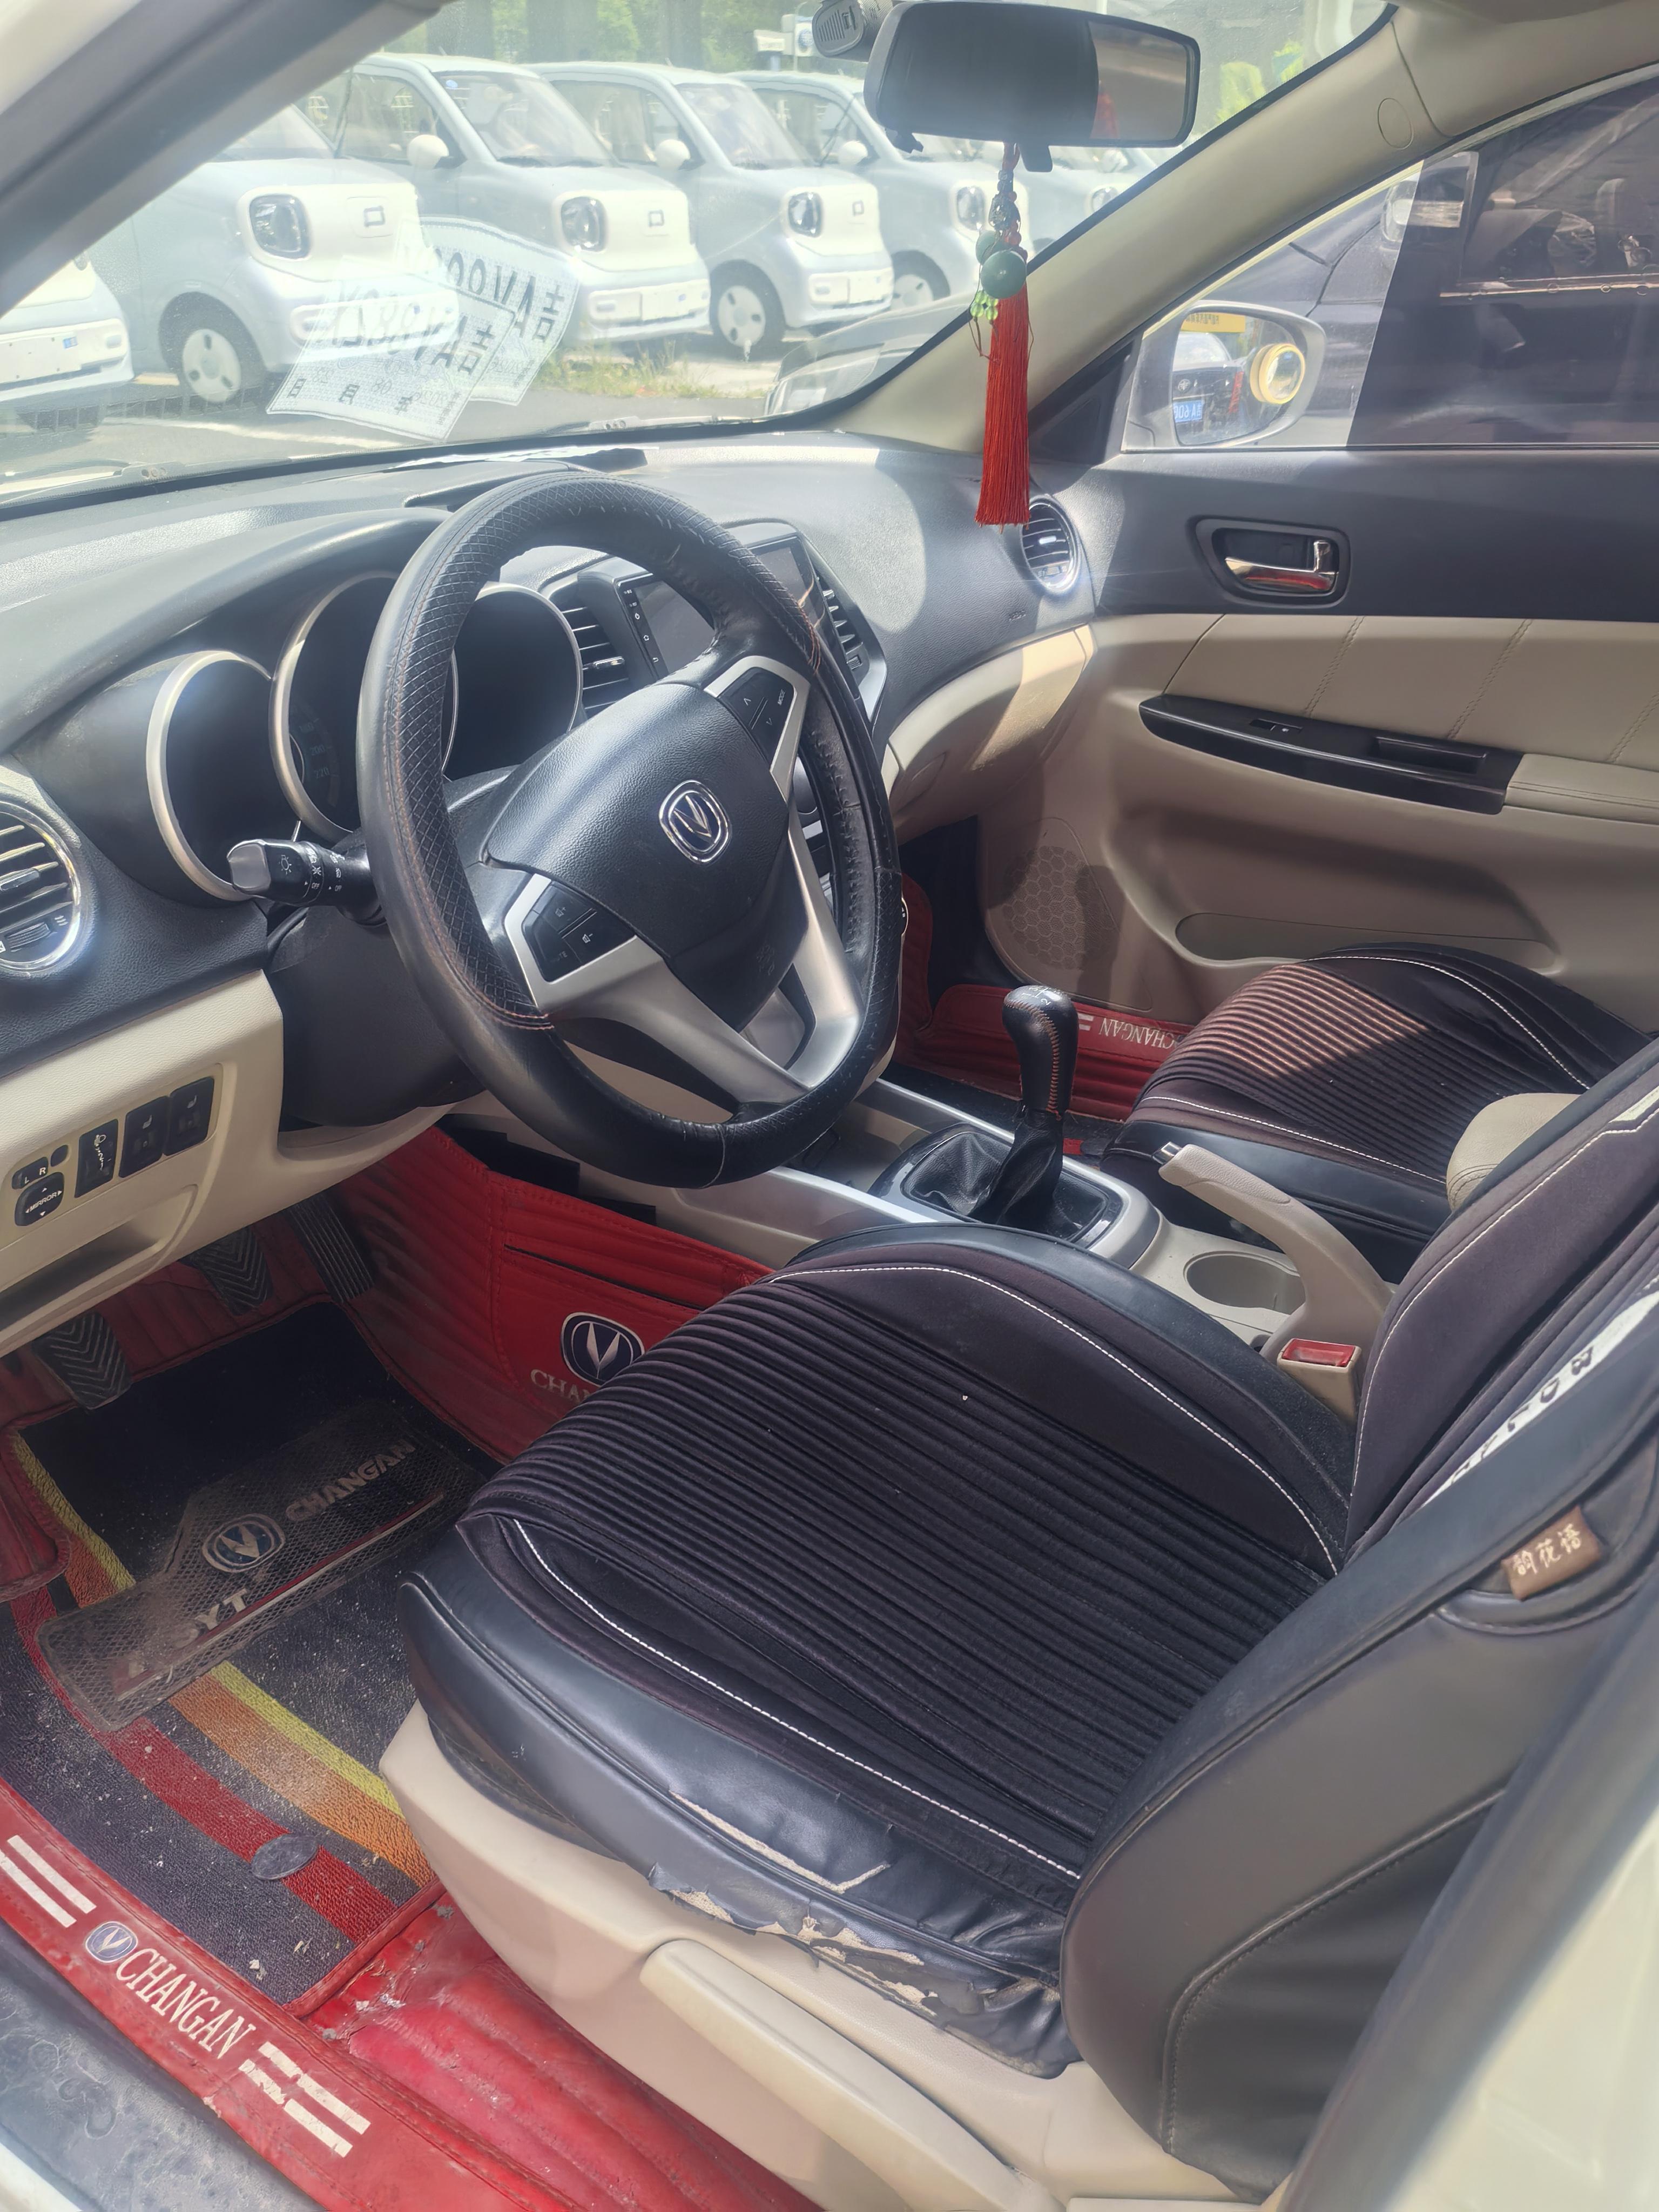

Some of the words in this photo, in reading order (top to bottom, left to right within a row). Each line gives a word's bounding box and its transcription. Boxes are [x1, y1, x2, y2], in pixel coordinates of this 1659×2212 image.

[1098, 1017, 1175, 1049] CHANGAN
[24, 1176, 30, 1184] L
[39, 1166, 46, 1176] R
[29, 1191, 58, 1212] MIRROR
[285, 1439, 416, 1522] CHANGAN
[115, 1947, 257, 2059] CHANGAN
